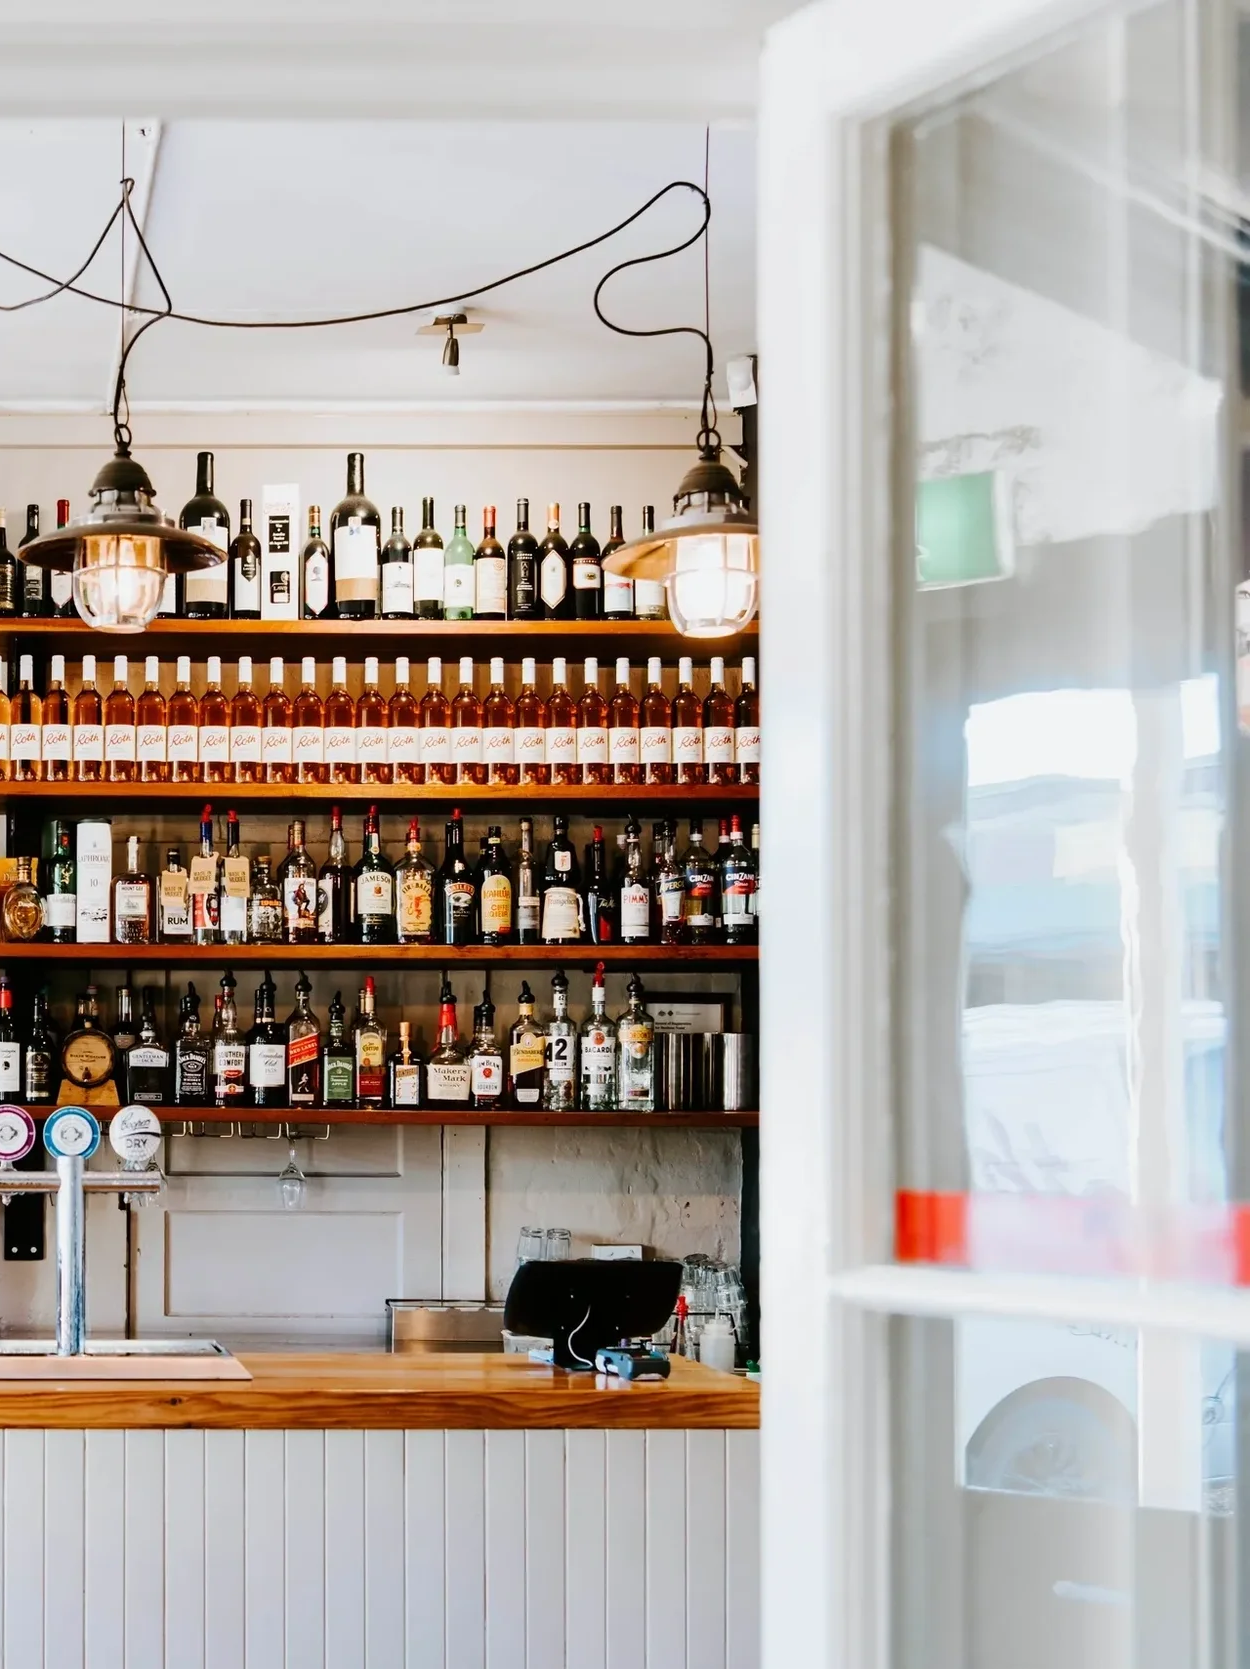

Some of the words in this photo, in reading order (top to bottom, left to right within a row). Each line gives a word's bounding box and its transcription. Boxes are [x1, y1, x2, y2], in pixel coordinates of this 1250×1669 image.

[13, 732, 36, 745] Roth
[44, 733, 67, 746] Roth
[75, 733, 99, 746] Roth
[108, 733, 132, 746] Roth
[140, 734, 164, 748] Roth
[170, 734, 193, 748] Roth
[203, 734, 226, 748] Roth
[232, 734, 256, 748] Roth
[264, 734, 287, 748] Roth
[296, 735, 320, 749] Roth
[326, 735, 350, 749] Roth
[359, 735, 383, 749] Roth
[390, 735, 414, 749] Roth
[422, 735, 447, 749] Roth
[455, 735, 479, 749] Roth
[487, 735, 510, 749] Roth
[520, 735, 543, 749] Roth
[551, 735, 574, 749] Roth
[580, 735, 605, 749] Roth
[614, 735, 637, 749] Roth
[642, 735, 667, 749] Roth
[678, 735, 701, 749] Roth
[708, 735, 731, 749] Roth
[736, 735, 760, 749] Roth
[90, 879, 98, 887] 10
[690, 874, 714, 883] CINZAN
[218, 1051, 244, 1059] SOUTHERN
[290, 1046, 301, 1054] RED
[302, 1042, 318, 1051] LABEL
[219, 1059, 244, 1067] COMFORT
[126, 1138, 148, 1148] DRY
